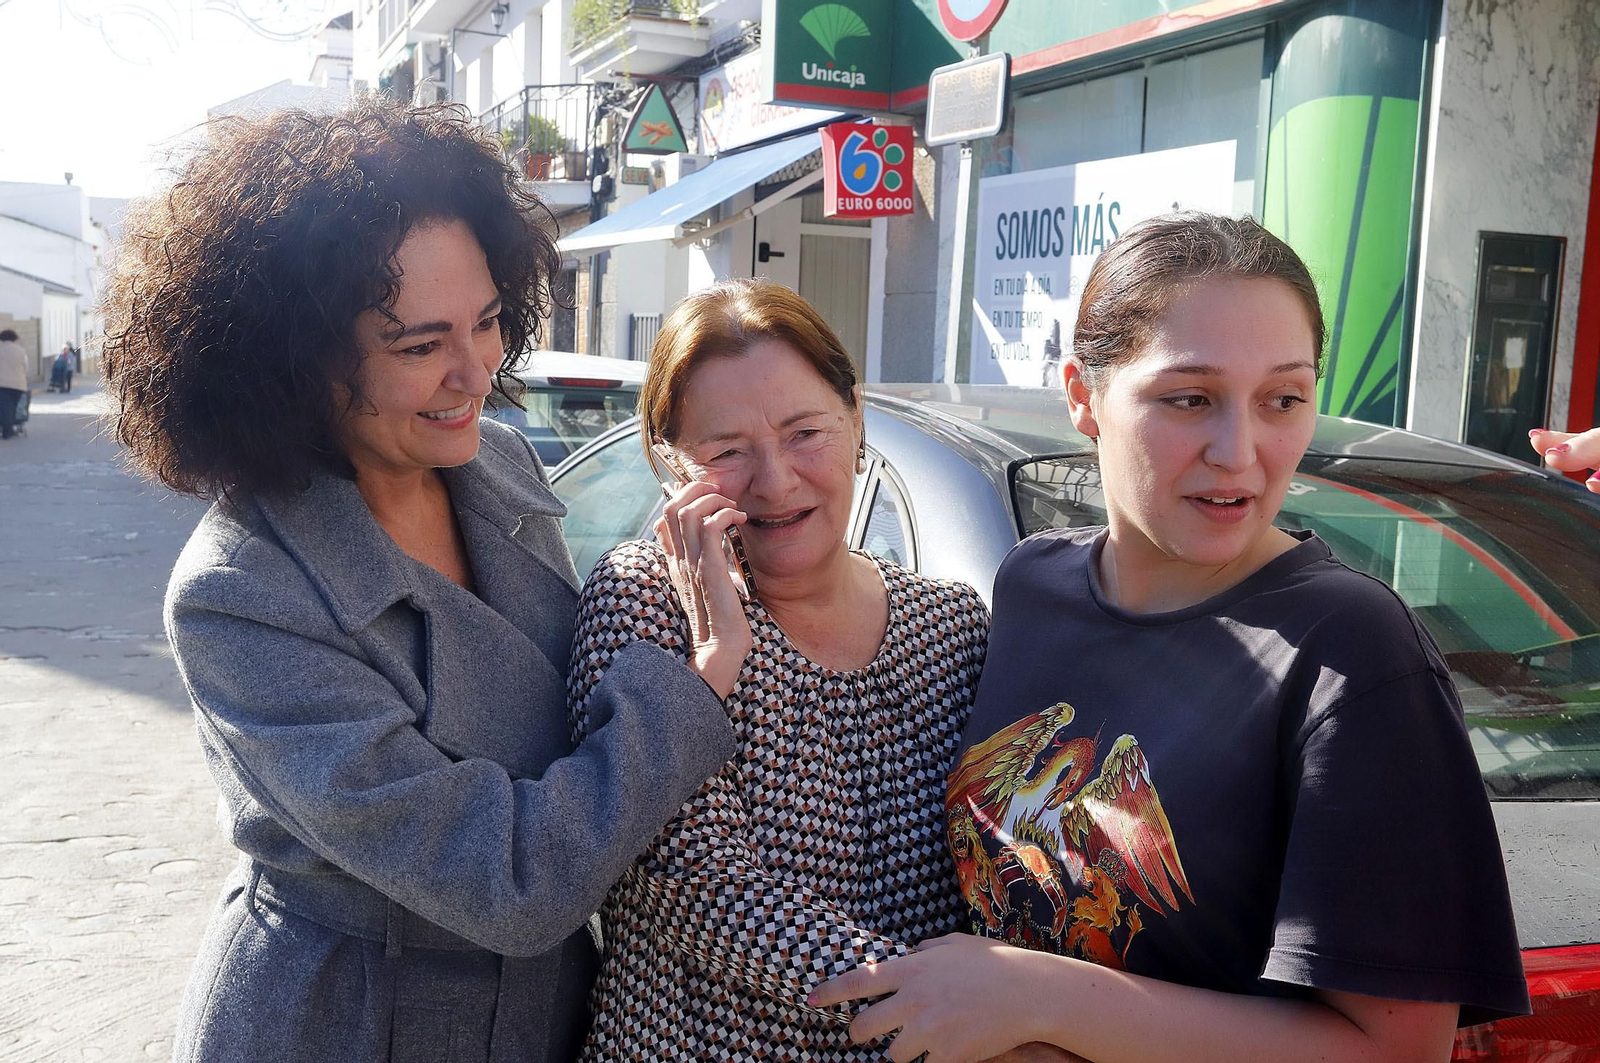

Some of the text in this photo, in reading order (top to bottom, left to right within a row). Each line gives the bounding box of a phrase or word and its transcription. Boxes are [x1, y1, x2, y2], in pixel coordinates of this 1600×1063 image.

[802, 62, 866, 88] Unicaja
[837, 197, 913, 210] EURO 6000
[995, 192, 1121, 260] SOMOS MÁS
[994, 278, 1004, 296] EN
[1006, 278, 1015, 296] TU
[1016, 274, 1028, 295] DÍA
[993, 310, 1003, 328] EN
[1004, 310, 1014, 328] TU
[991, 342, 1000, 360] EN
[1003, 342, 1011, 361] TU
